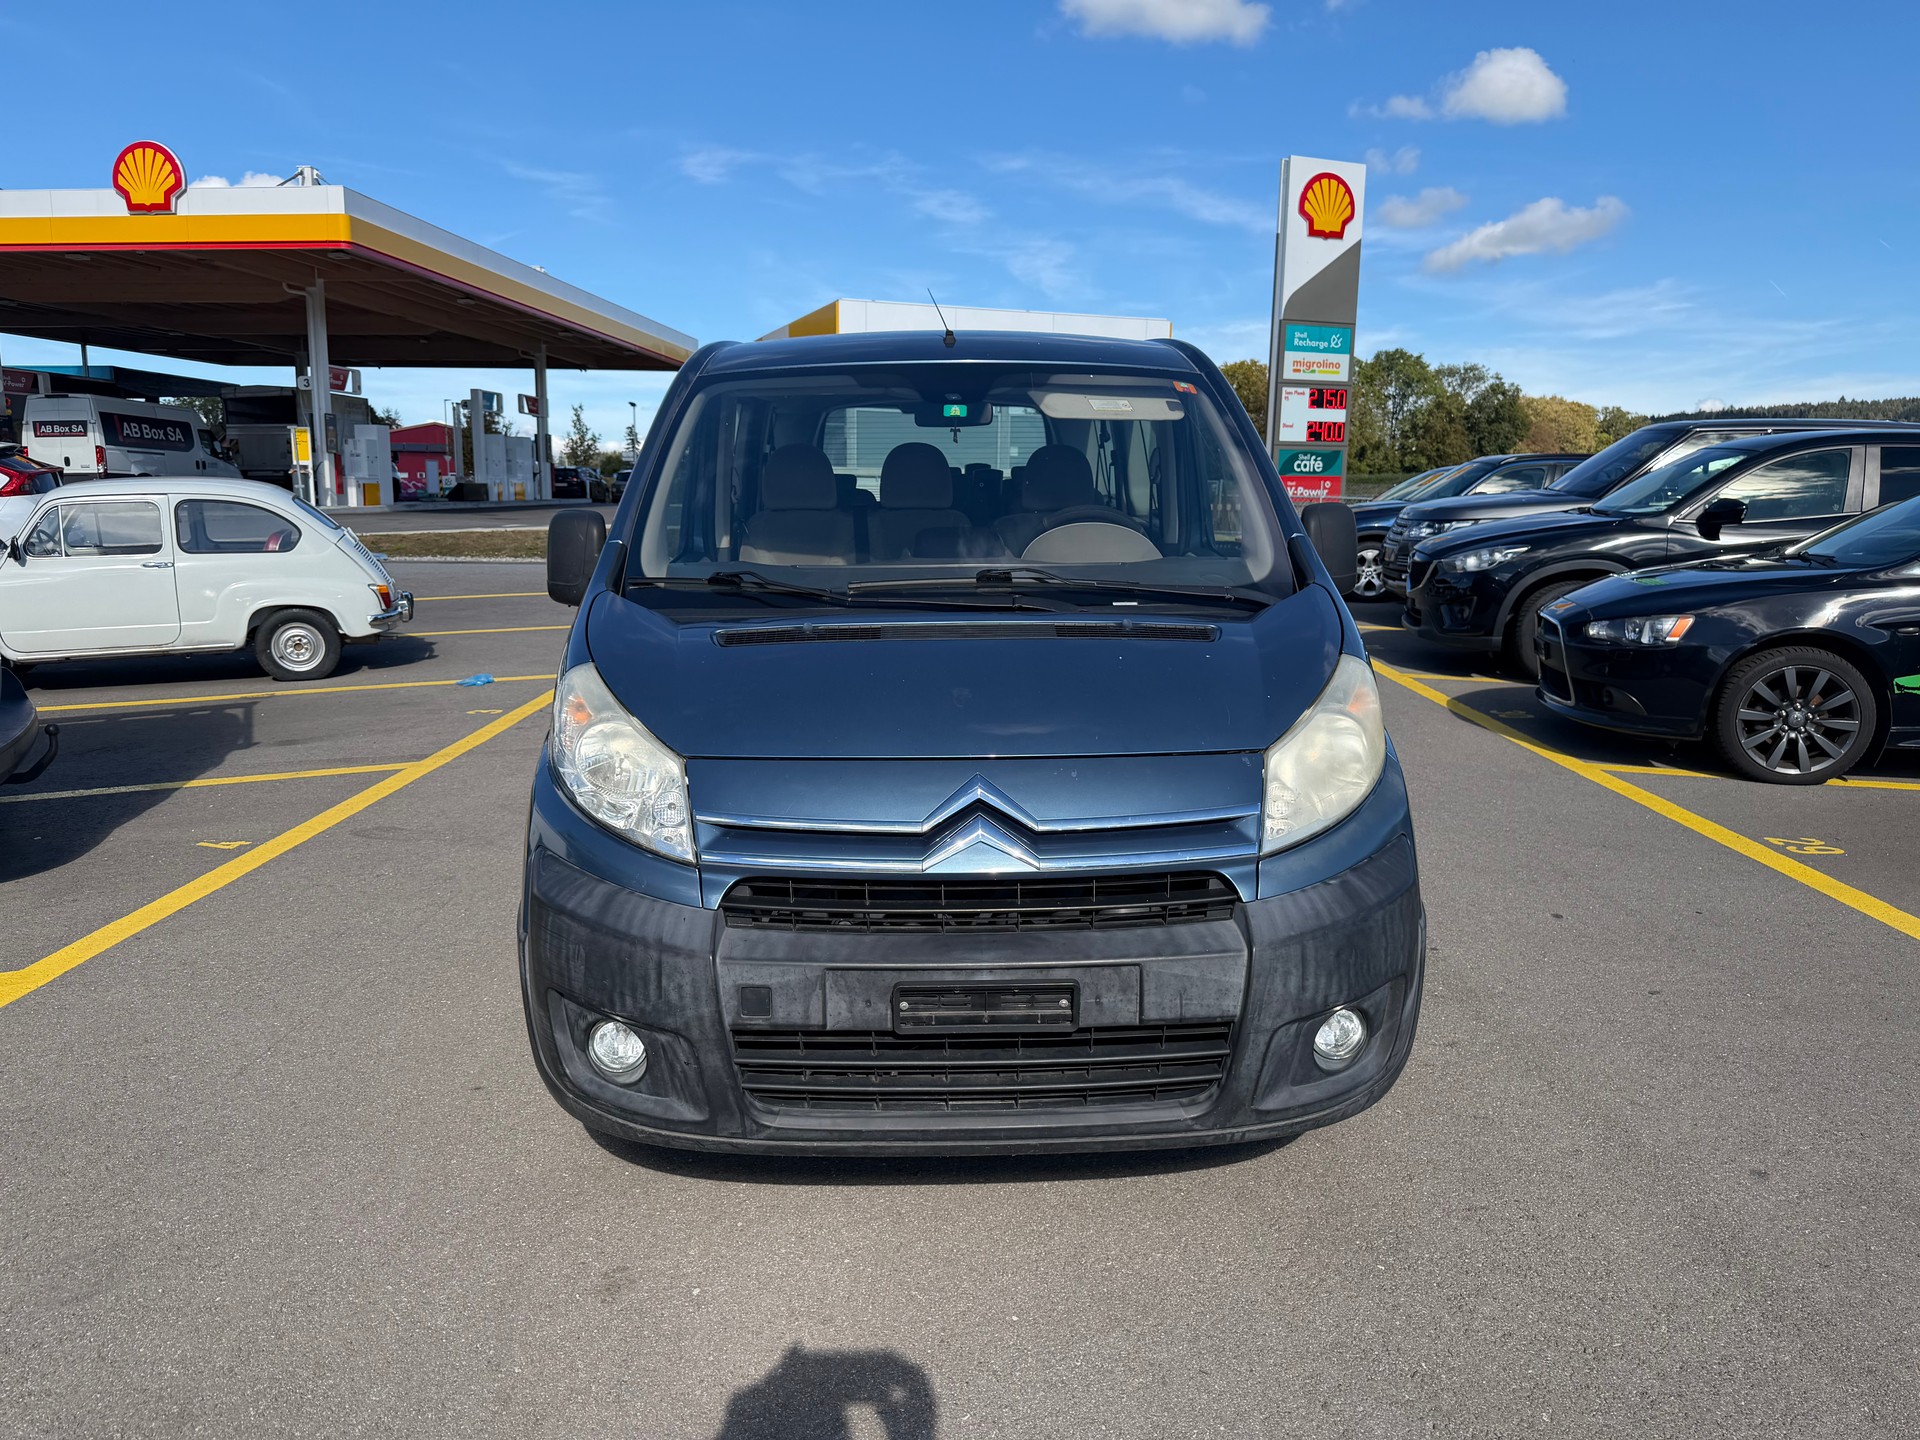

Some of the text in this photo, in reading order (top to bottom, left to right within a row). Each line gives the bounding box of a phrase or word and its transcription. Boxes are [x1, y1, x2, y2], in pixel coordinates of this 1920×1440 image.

[1294, 331, 1308, 339] Shell
[1293, 338, 1329, 350] Recharge
[1292, 358, 1341, 371] migrolino
[303, 378, 310, 388] 3
[40, 424, 84, 433] AB Box SA
[123, 421, 185, 442] AB Box SA
[1306, 421, 1345, 442] 240.0
[1297, 453, 1311, 461] Shell
[1293, 456, 1324, 473] café
